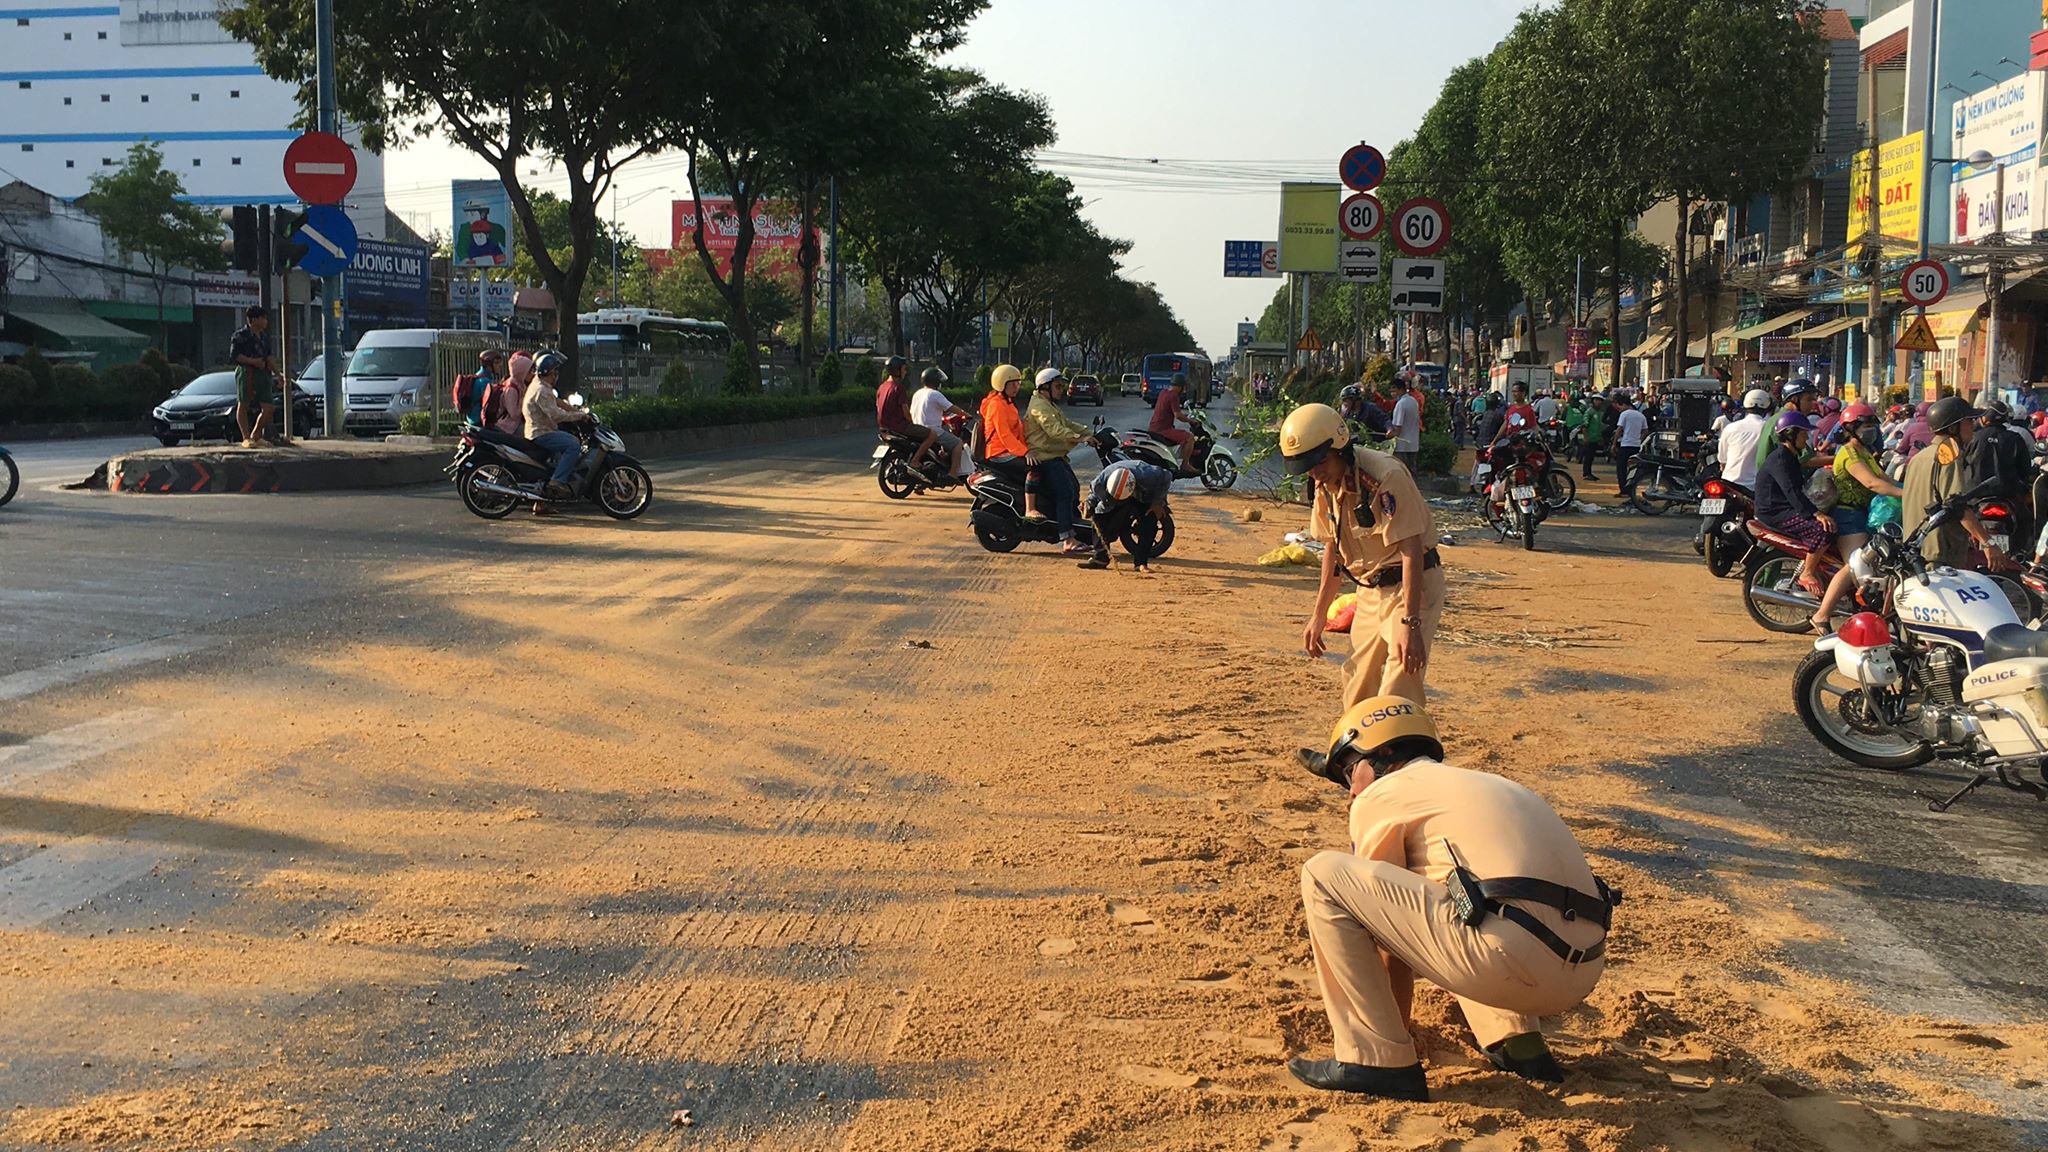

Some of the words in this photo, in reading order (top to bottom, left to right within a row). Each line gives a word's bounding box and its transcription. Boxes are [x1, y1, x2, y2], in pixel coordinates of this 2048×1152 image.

[1984, 95, 1997, 115] KIM
[1885, 177, 1912, 206] ĐẤT
[2005, 190, 2029, 221] KHOA
[1350, 206, 1372, 228] 80
[1405, 214, 1435, 241] 60
[394, 257, 421, 276] LINH
[1915, 274, 1935, 294] 50
[1955, 585, 1990, 605] A5
[1970, 668, 2018, 687] POLICE
[1361, 704, 1413, 728] CSGT
